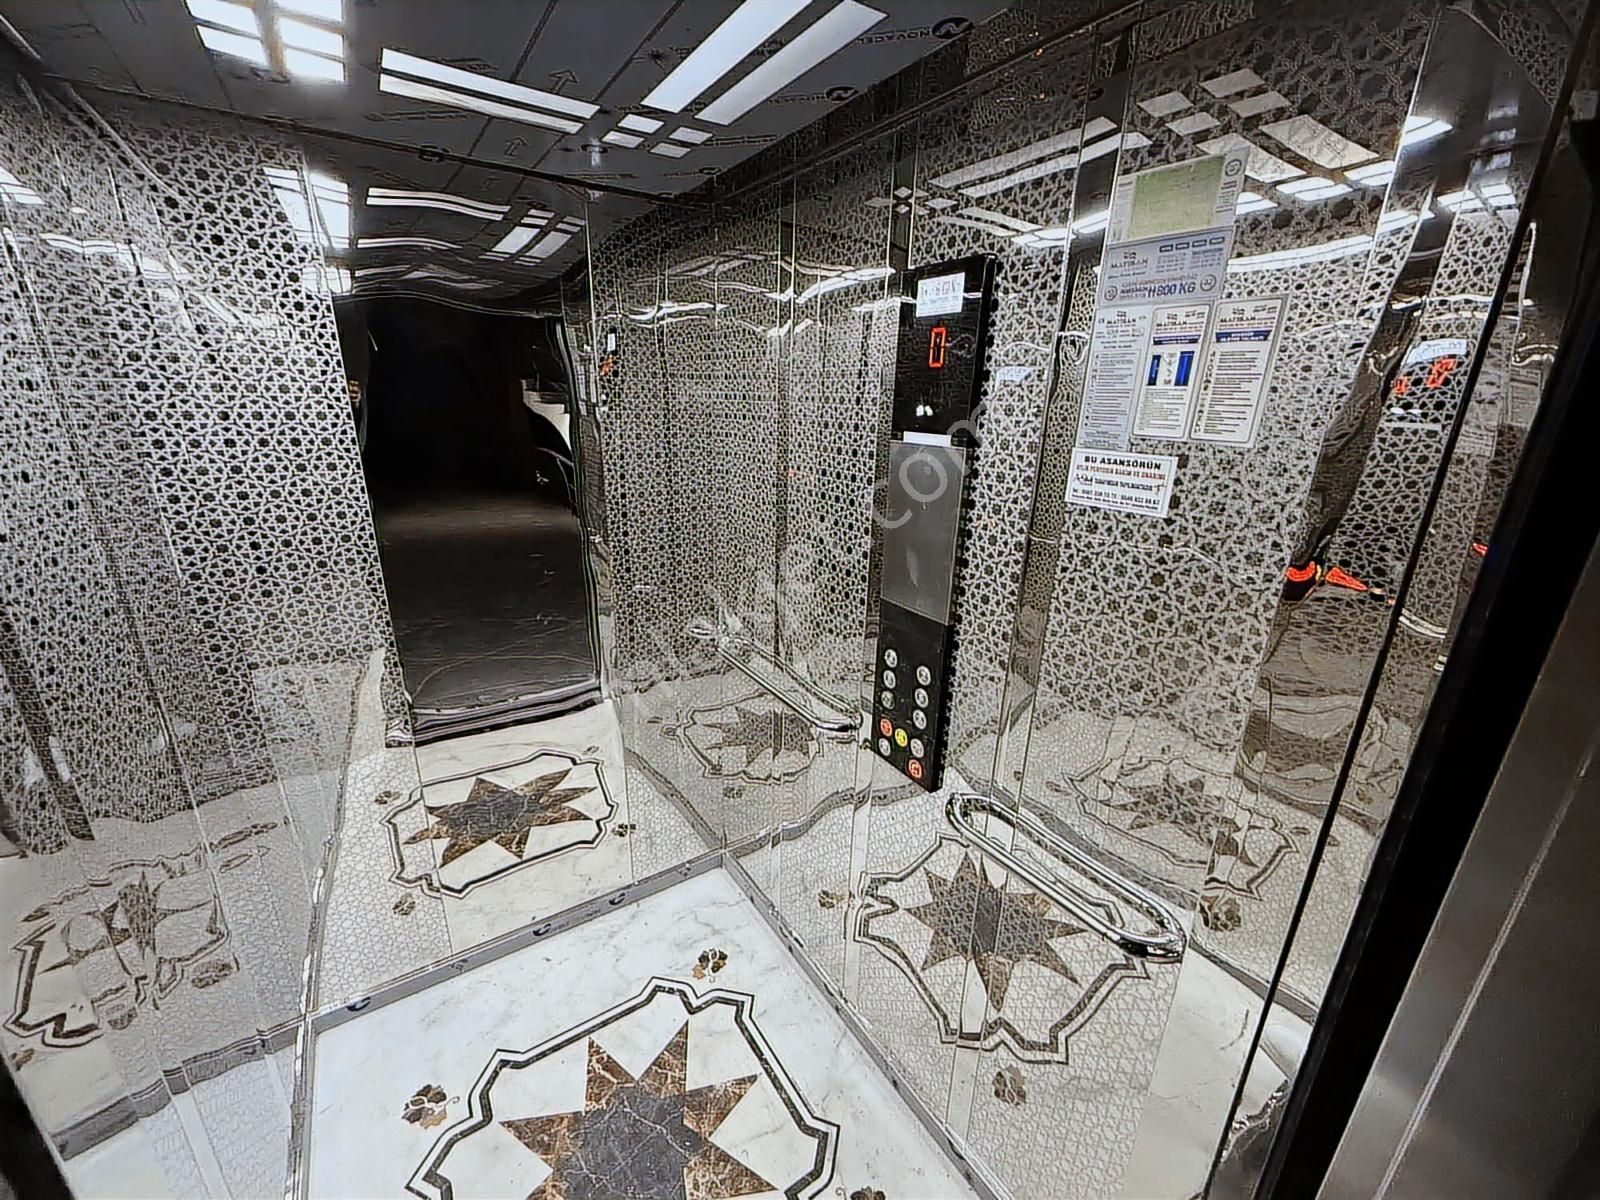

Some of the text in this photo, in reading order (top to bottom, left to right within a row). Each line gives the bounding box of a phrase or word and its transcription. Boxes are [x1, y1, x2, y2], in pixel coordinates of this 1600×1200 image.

[1179, 281, 1196, 295] KG
[929, 327, 947, 368] 0
[1084, 455, 1097, 463] BU
